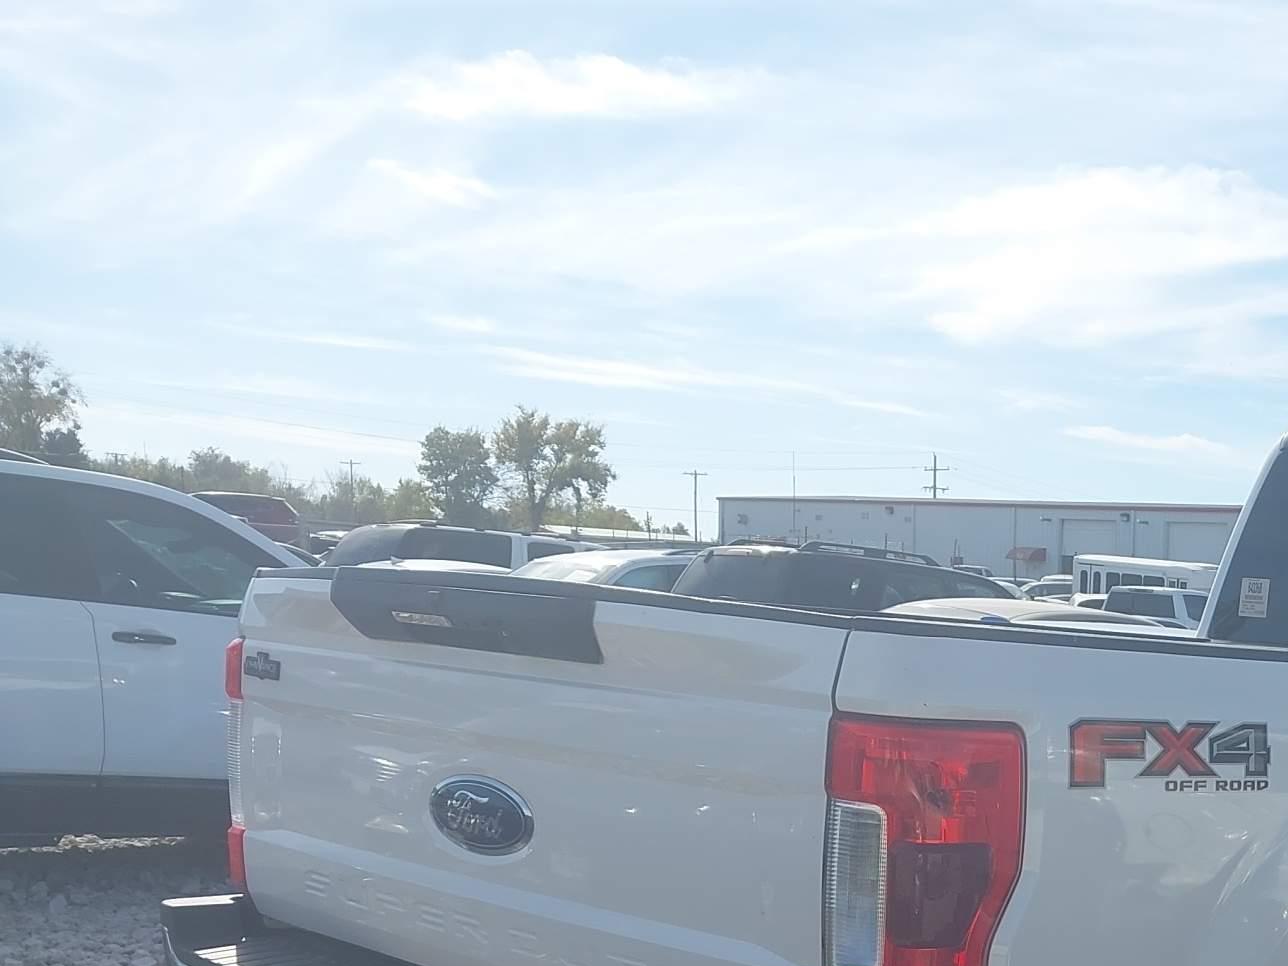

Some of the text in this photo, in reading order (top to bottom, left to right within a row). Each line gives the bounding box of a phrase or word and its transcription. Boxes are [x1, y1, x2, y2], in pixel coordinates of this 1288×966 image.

[1070, 719, 1271, 788] FX4
[1164, 780, 1269, 792] OFF ROAD
[303, 870, 490, 944] SUPER
